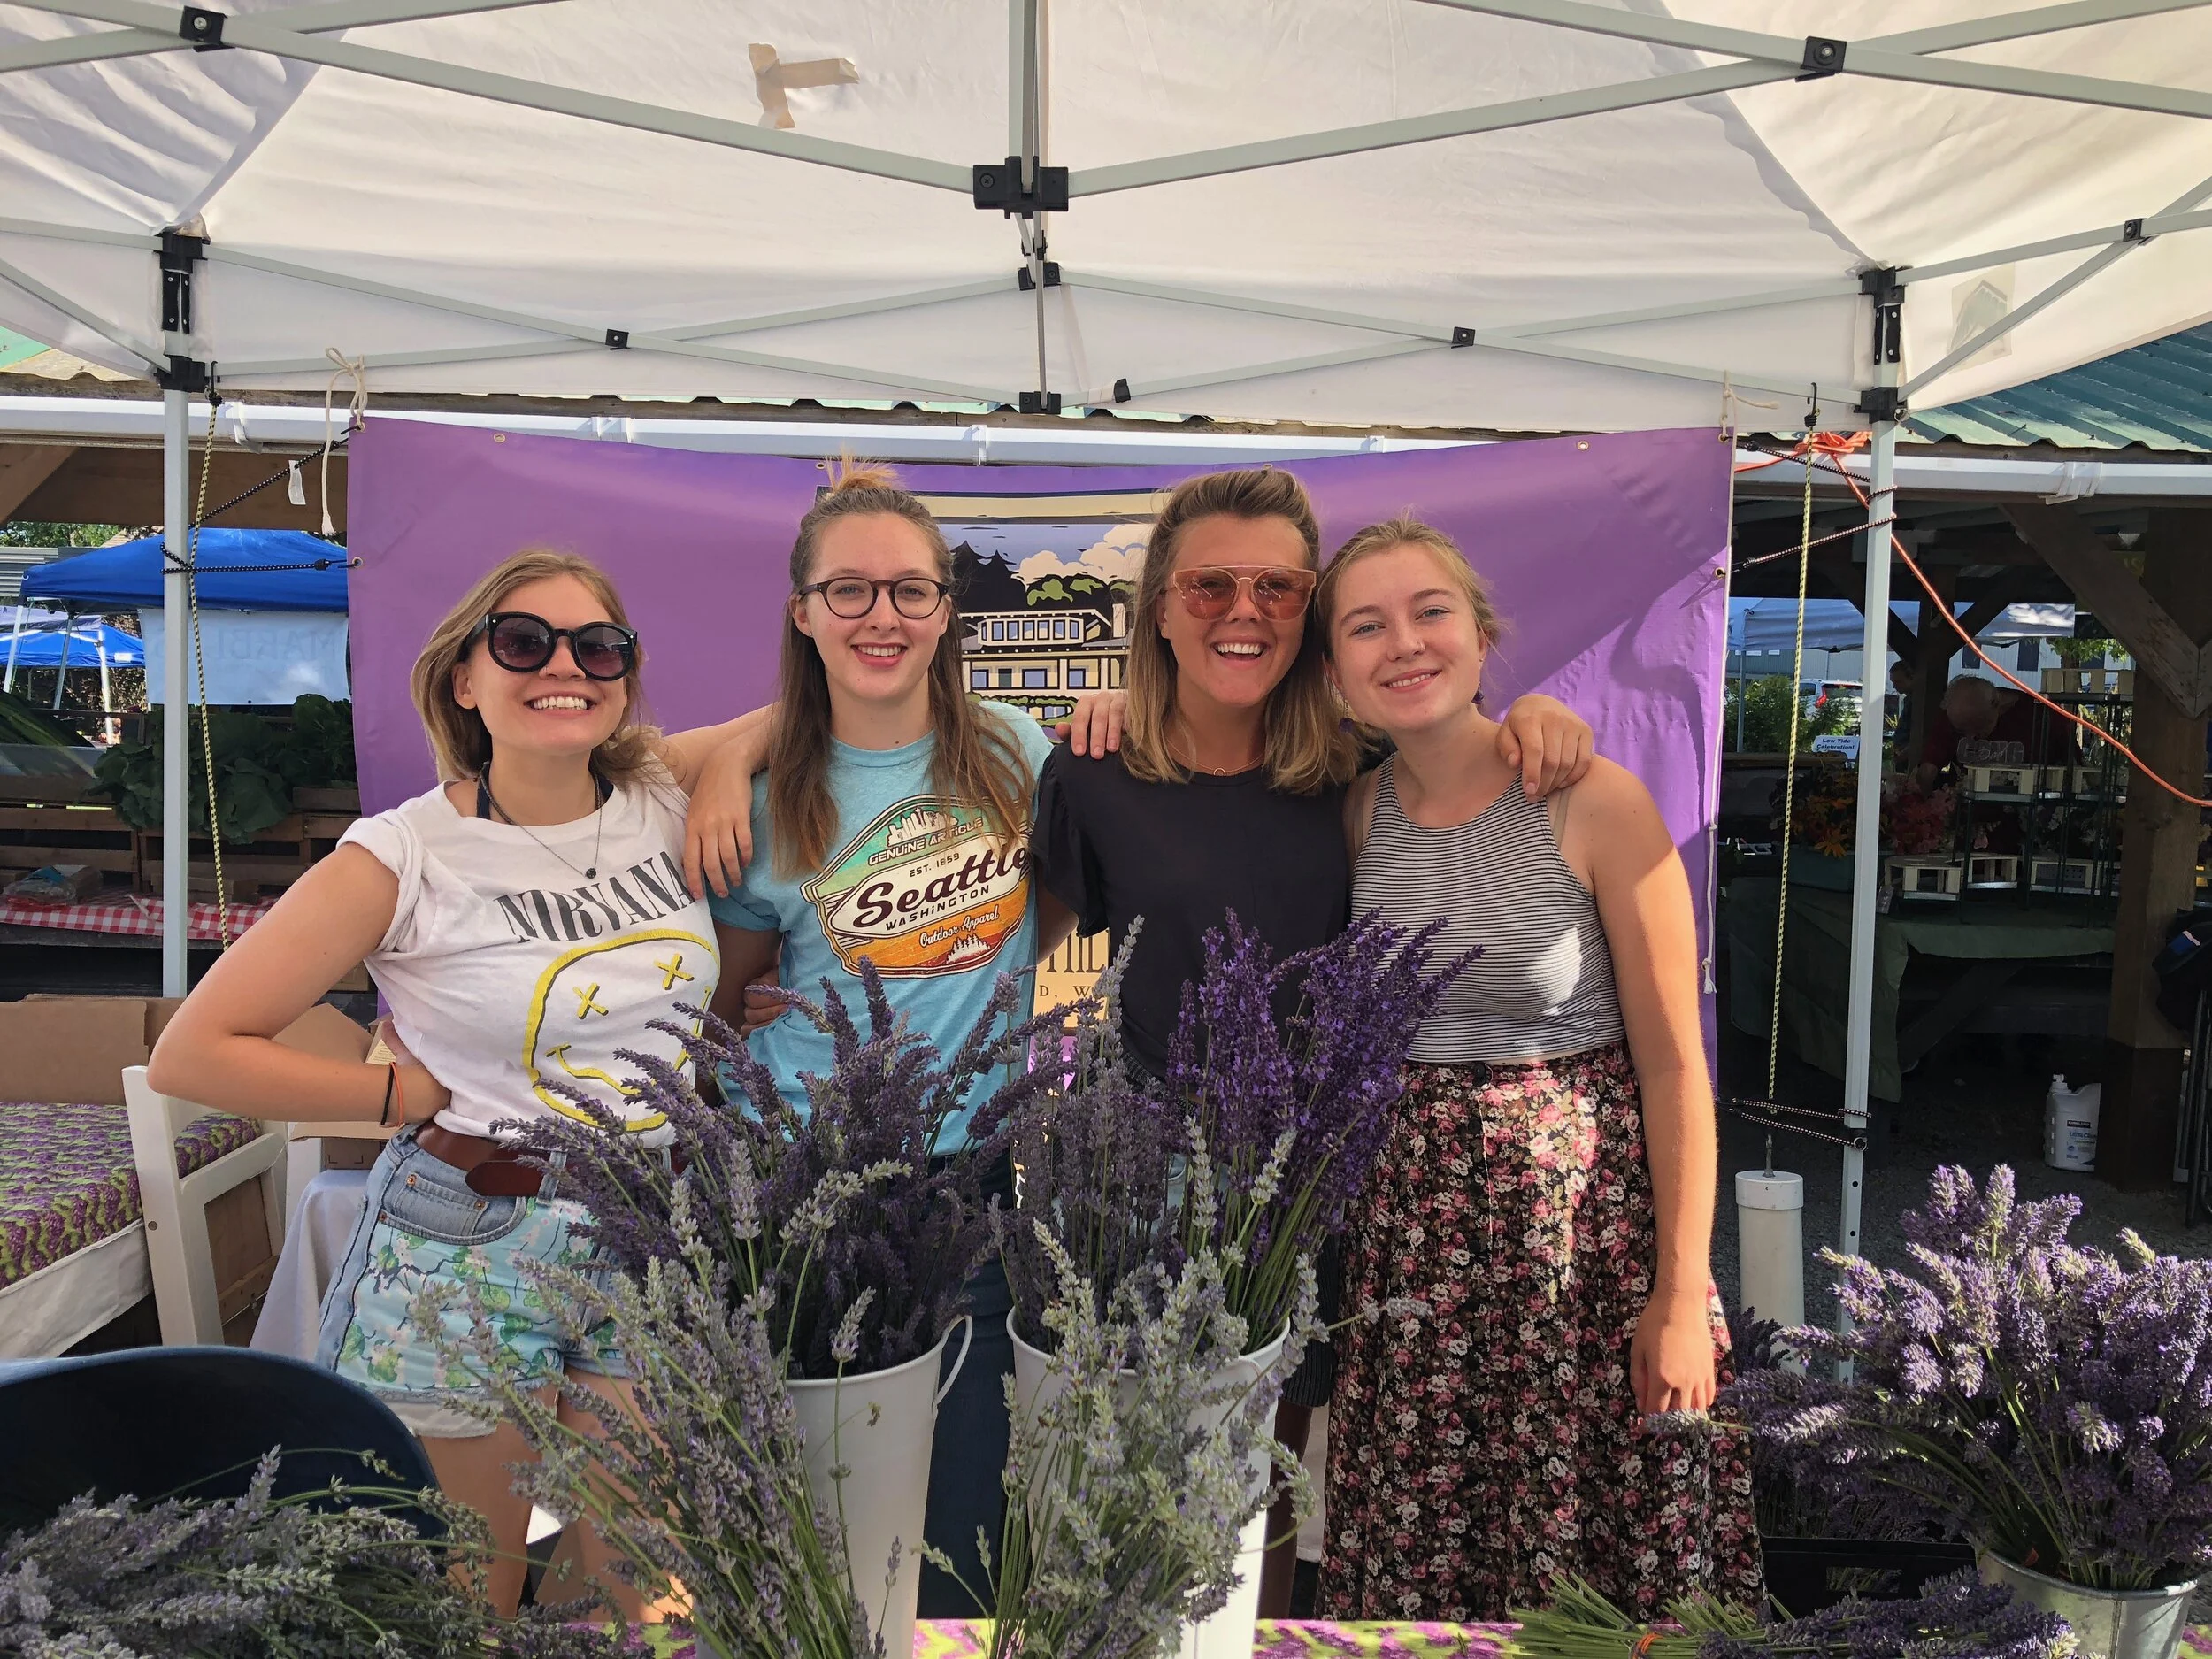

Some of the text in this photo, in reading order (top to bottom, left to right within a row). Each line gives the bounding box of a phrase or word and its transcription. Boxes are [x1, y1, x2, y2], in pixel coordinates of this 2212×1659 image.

[852, 845, 1026, 928] Seattle
[910, 852, 960, 878] EST. 1853
[493, 850, 696, 944] NIRVANA
[919, 904, 1000, 948] Outdoor Apparel
